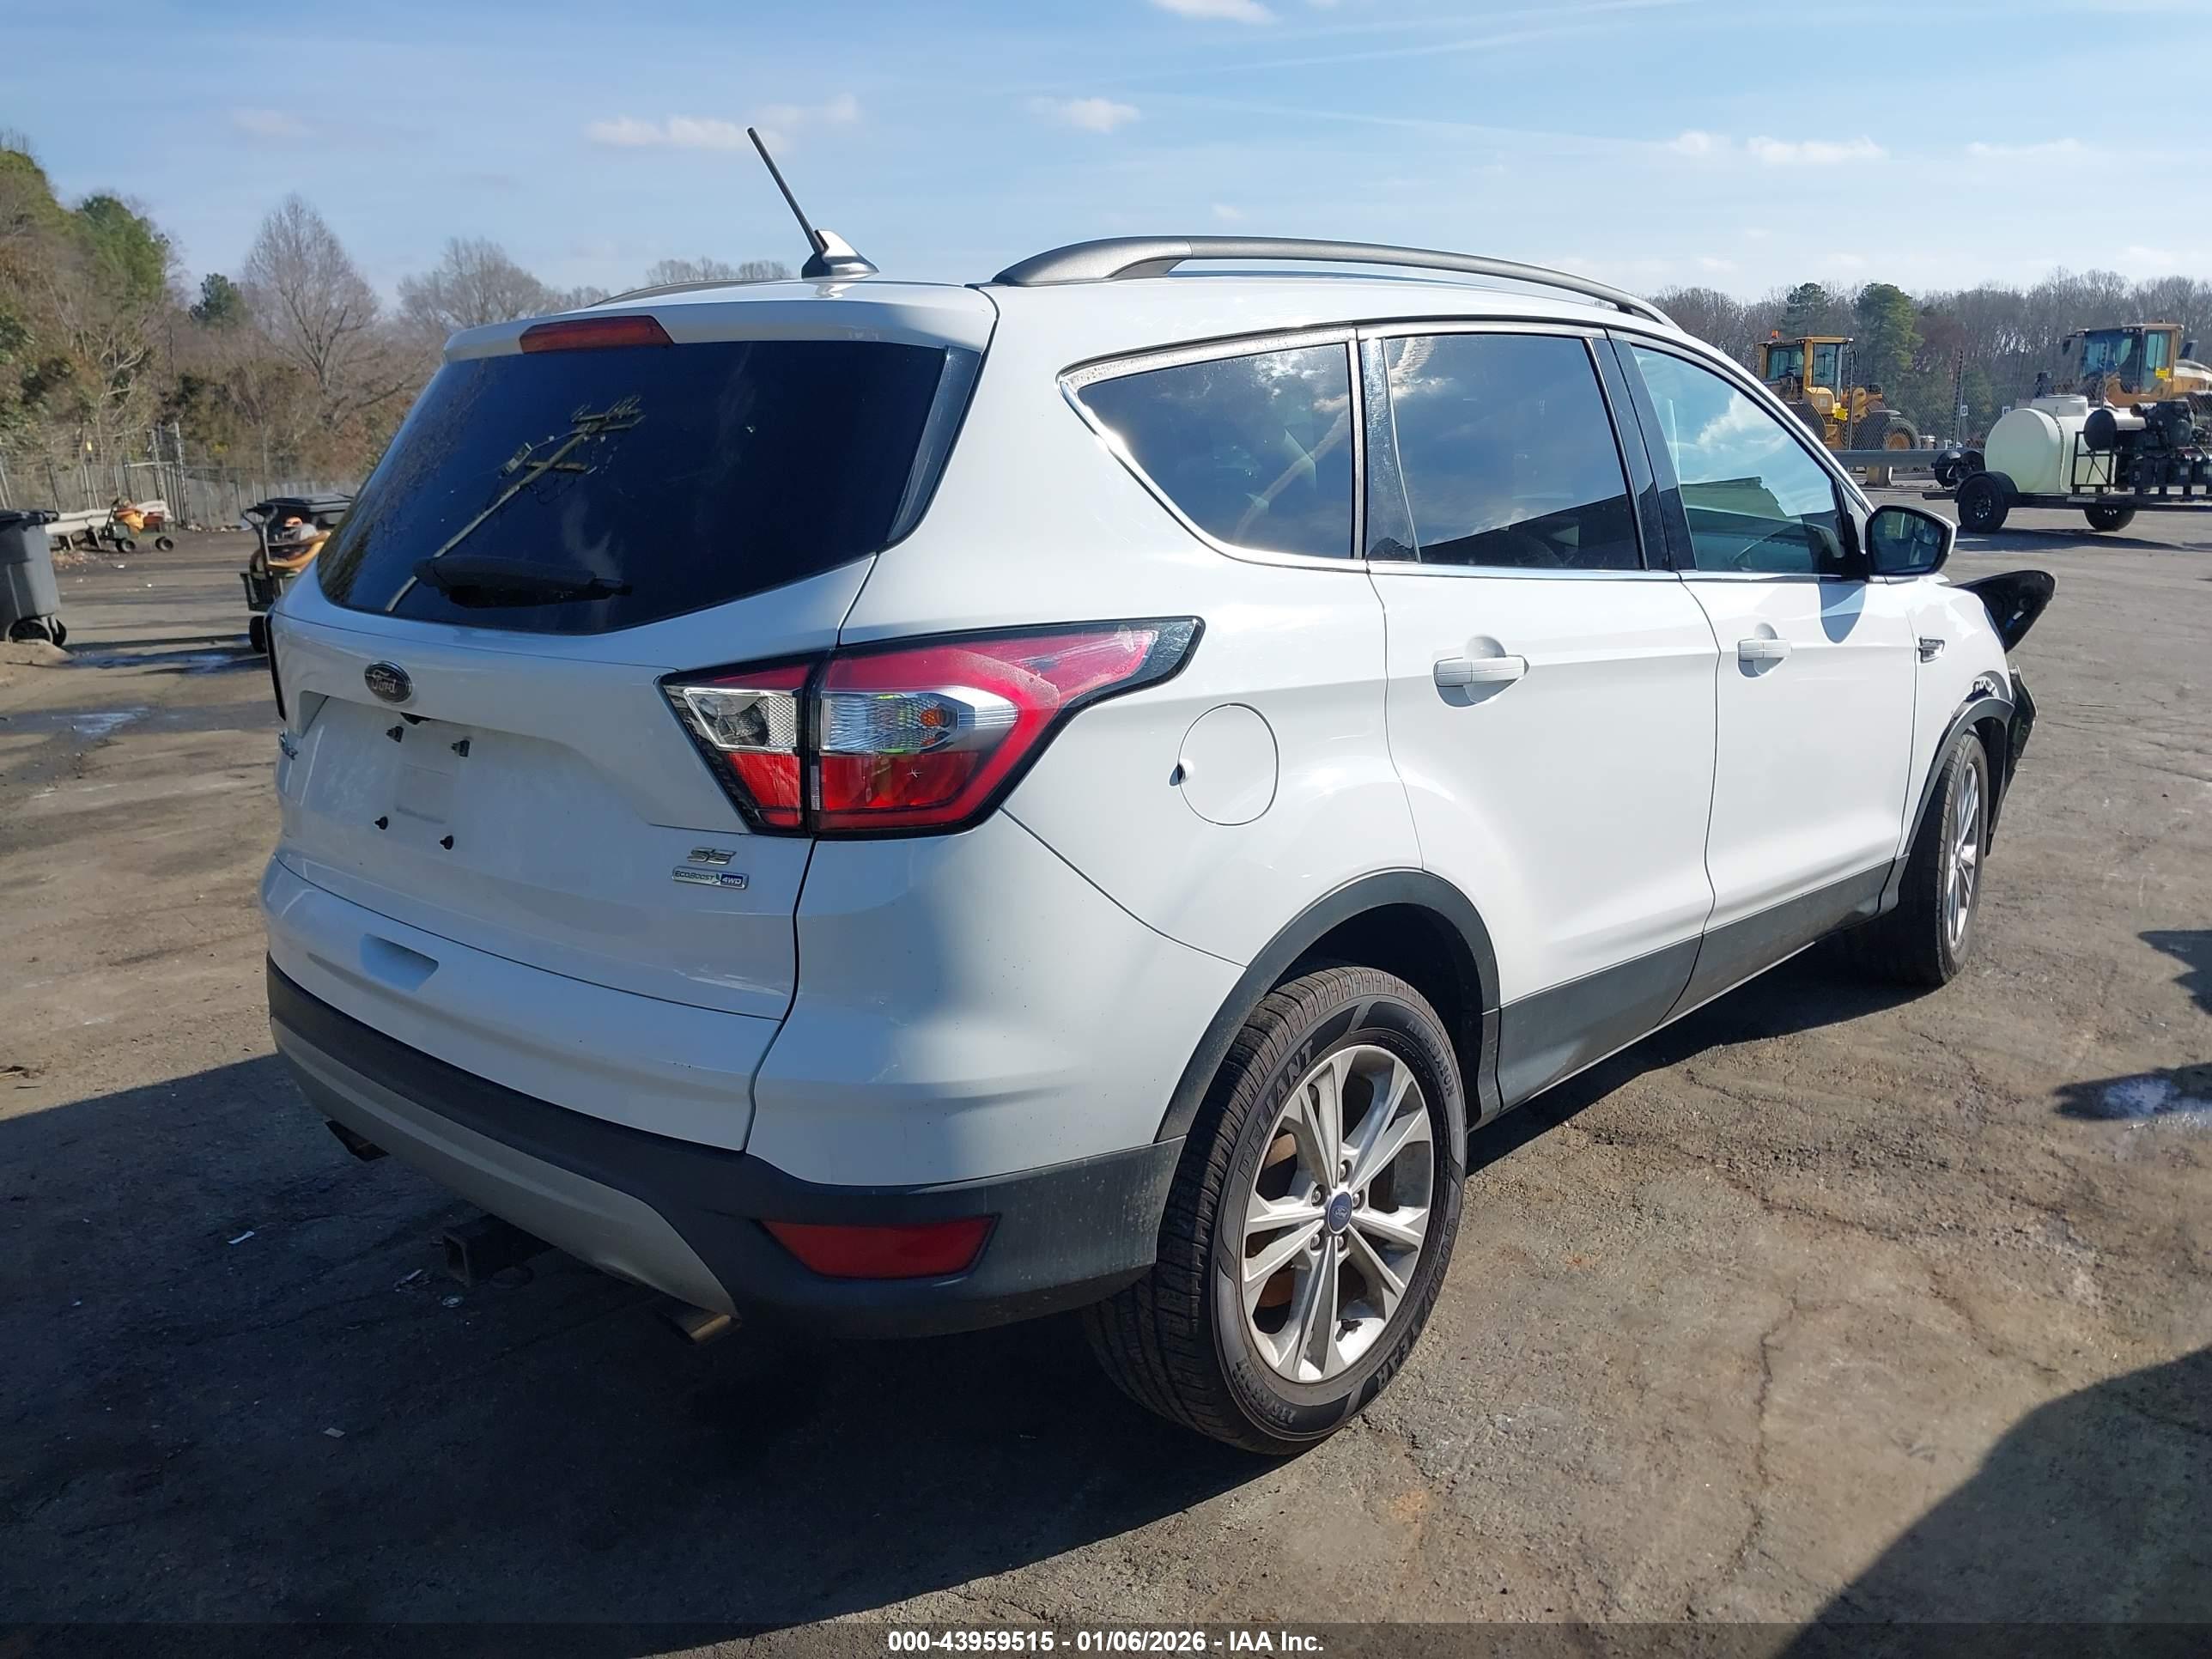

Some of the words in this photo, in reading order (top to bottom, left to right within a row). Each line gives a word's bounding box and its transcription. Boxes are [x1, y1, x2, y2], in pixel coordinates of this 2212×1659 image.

[366, 669, 397, 694] Ford
[686, 847, 737, 866] SE
[674, 870, 714, 881] ECOBOOST
[722, 876, 742, 884] 4WD
